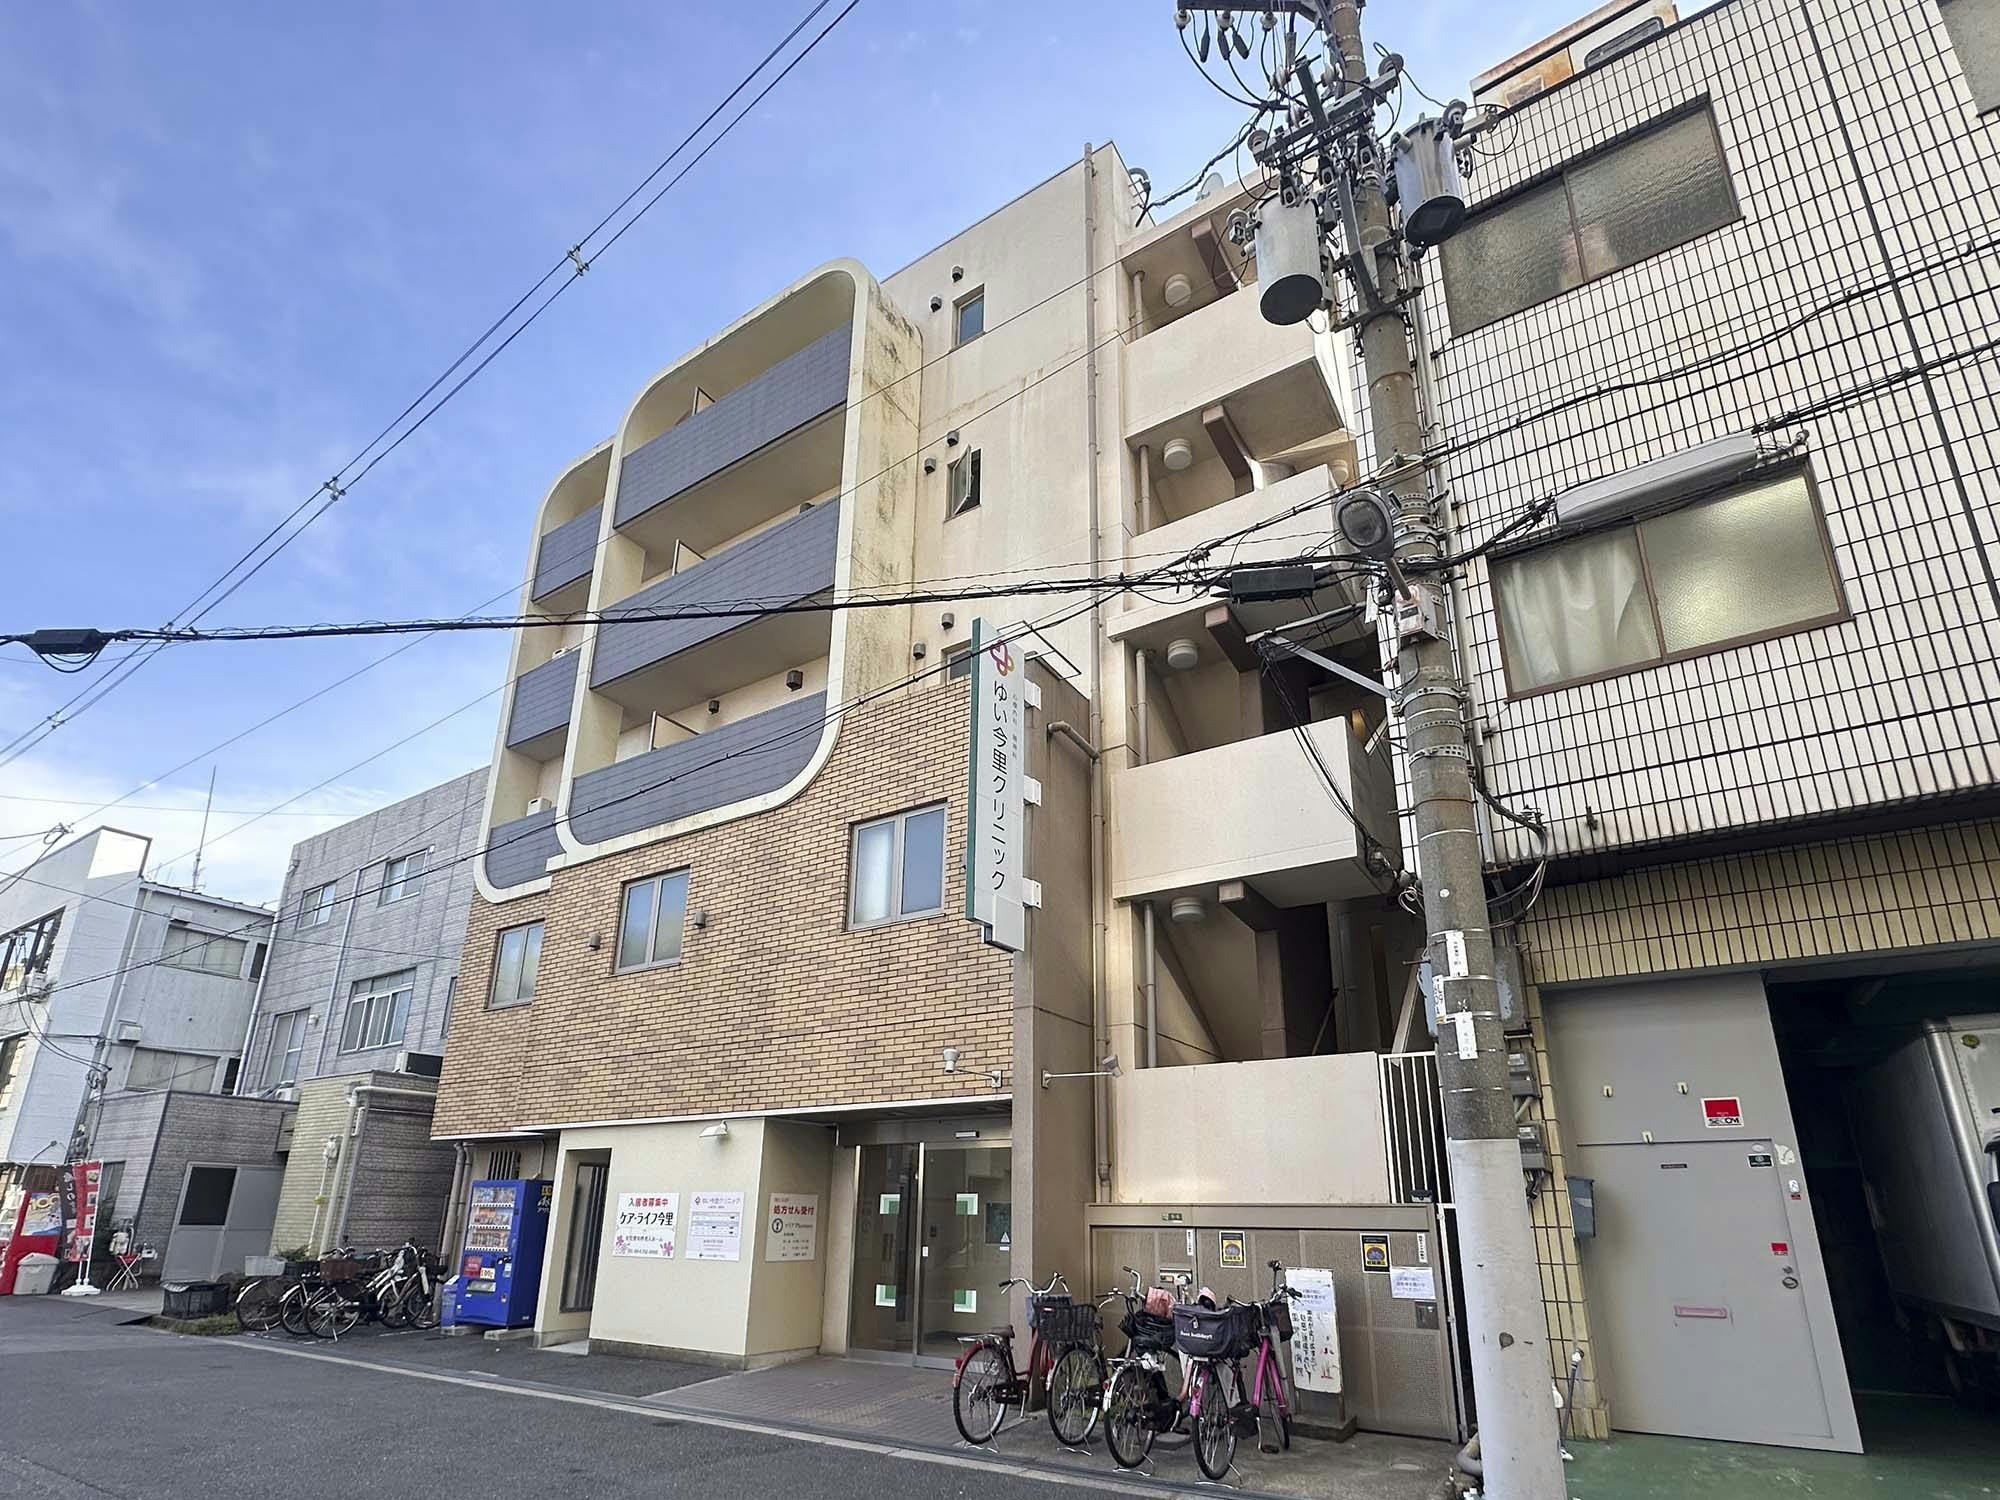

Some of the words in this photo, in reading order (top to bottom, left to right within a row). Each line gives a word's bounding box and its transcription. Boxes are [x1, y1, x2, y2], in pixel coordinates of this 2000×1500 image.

[991, 680, 1008, 890] ゆい今里クリニック
[628, 1197, 669, 1207] 入居者募集中
[774, 1205, 815, 1215] 処方せん受付
[620, 1211, 674, 1226] ケア・ライフ今里
